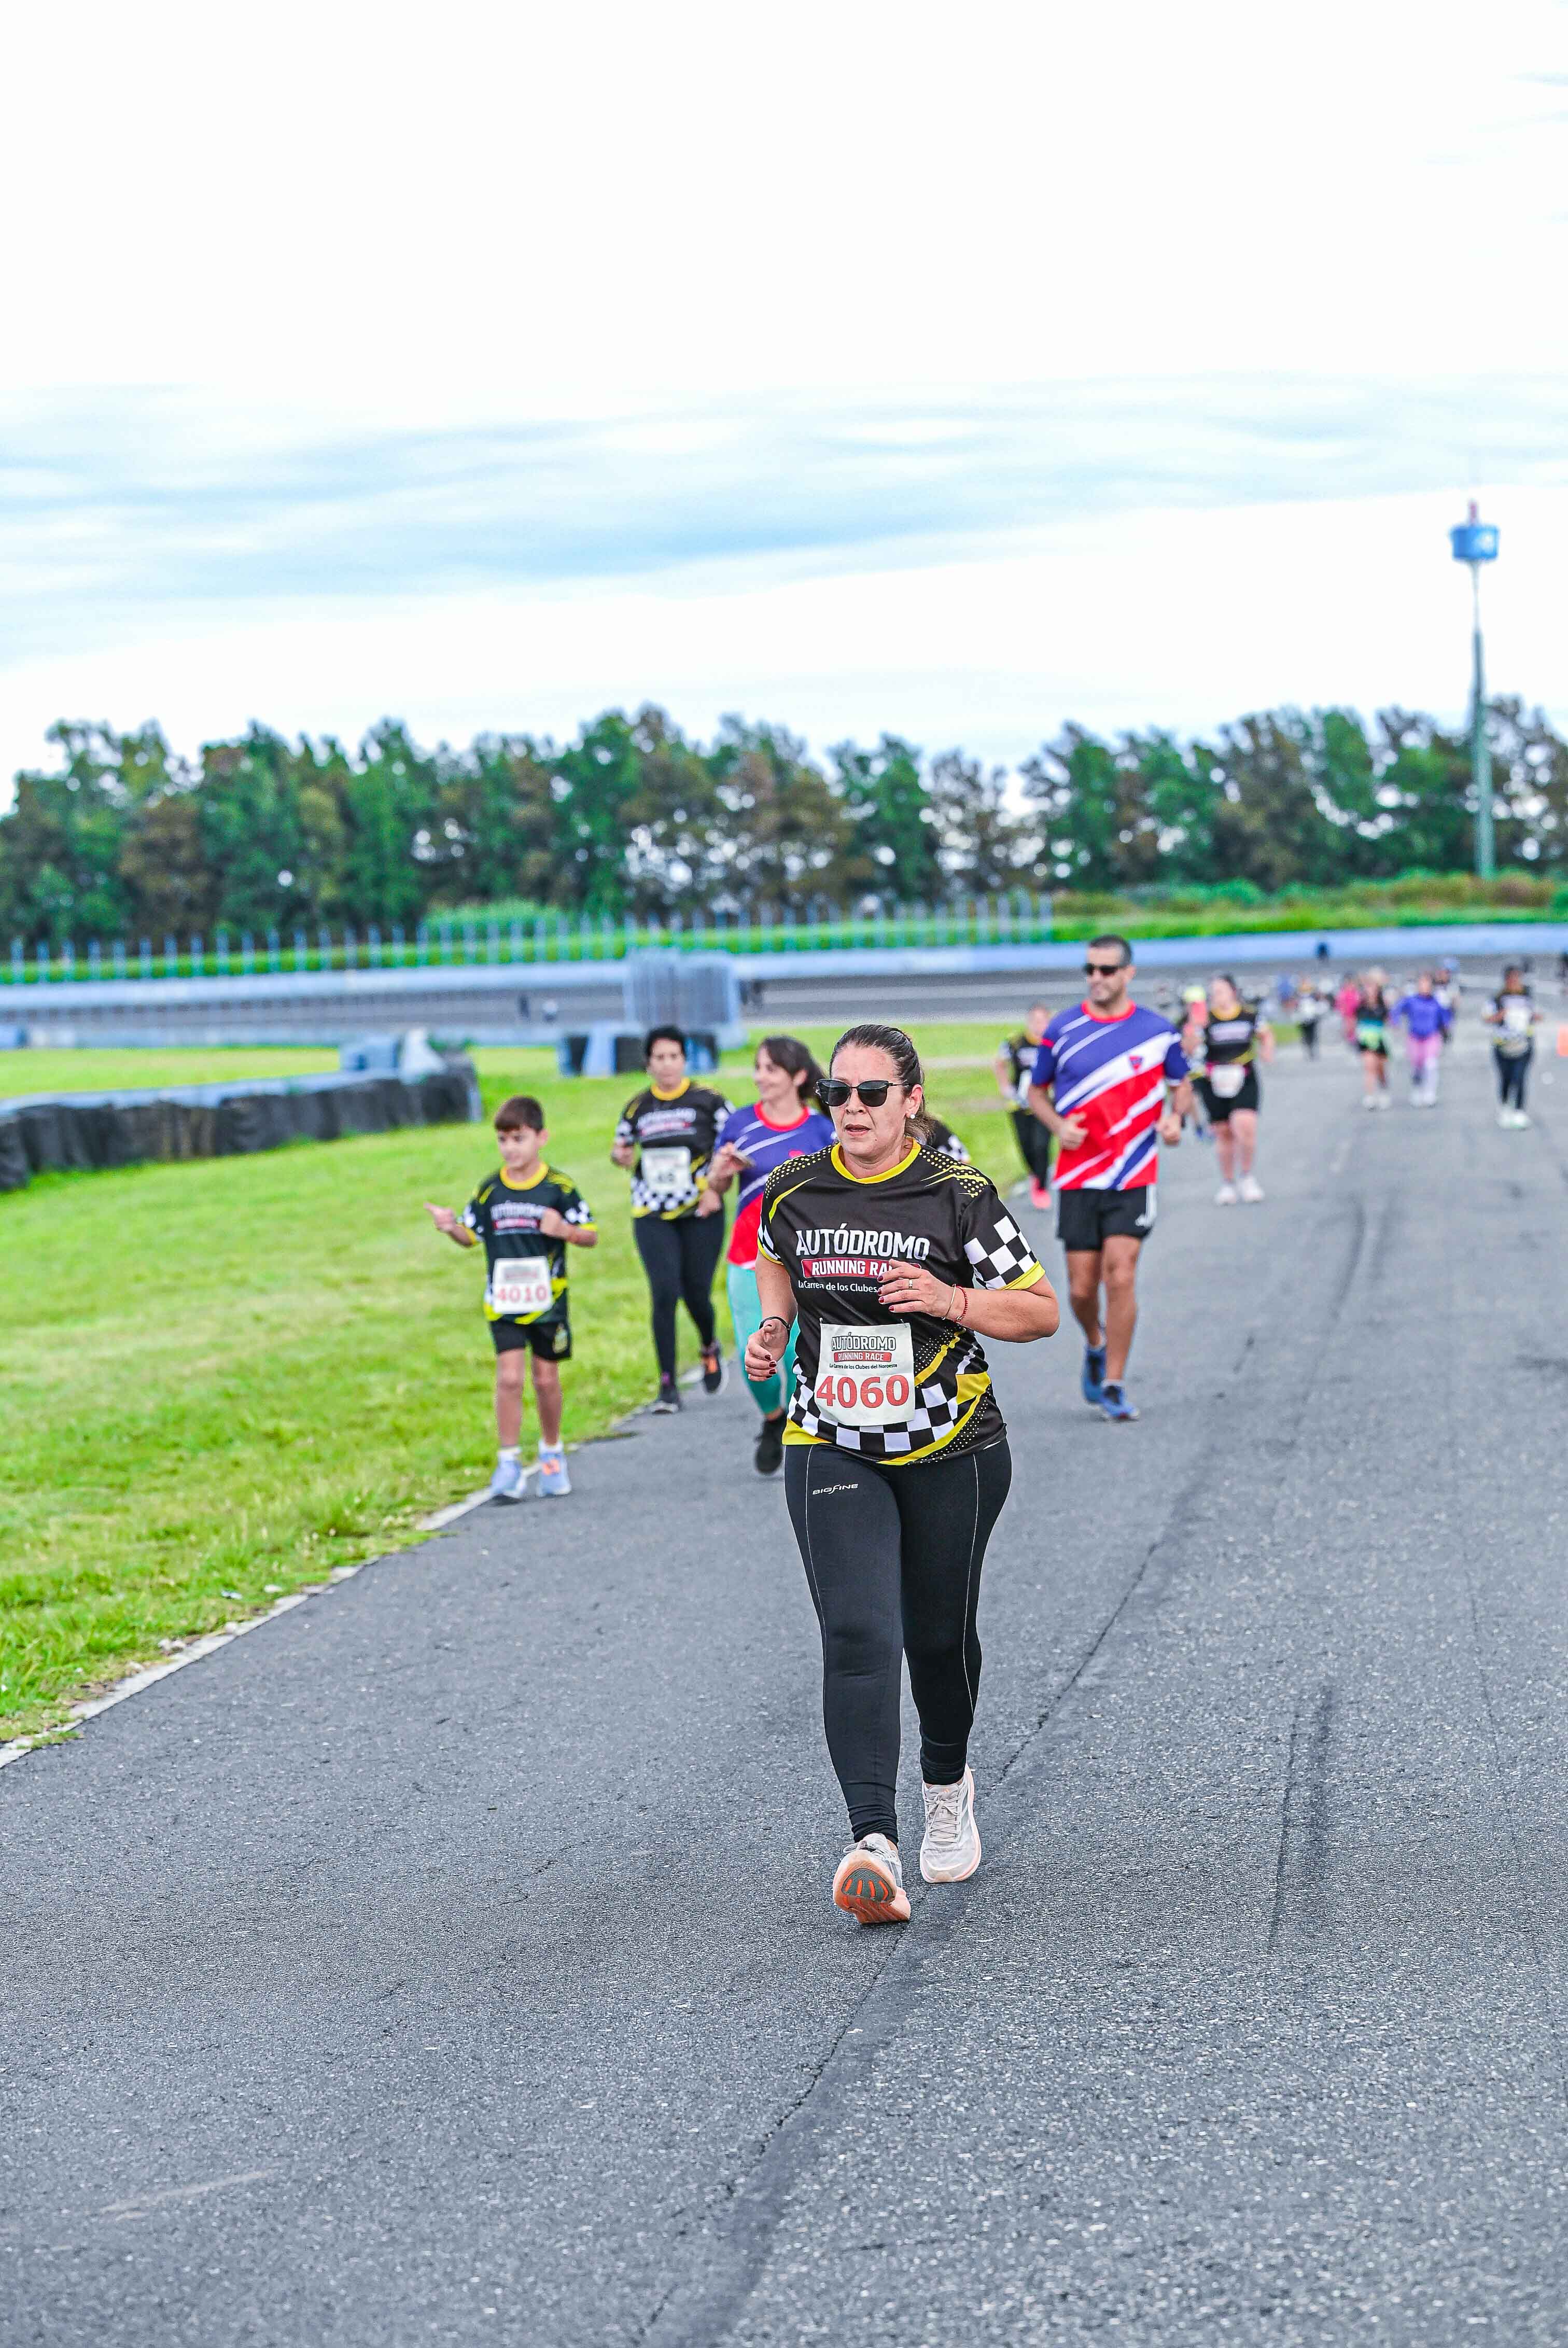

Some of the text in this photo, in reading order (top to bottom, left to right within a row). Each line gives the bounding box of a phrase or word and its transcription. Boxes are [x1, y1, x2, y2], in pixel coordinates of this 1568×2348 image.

[795, 1223, 930, 1261] AUTÓDROMO
[811, 1259, 892, 1277] RUNNING RA
[497, 1284, 548, 1303] 4010
[825, 1282, 836, 1291] de
[837, 1282, 849, 1291] los
[850, 1283, 878, 1293] Clubes
[831, 1332, 896, 1351] AUTÓDROMO
[838, 1352, 884, 1361] RUNNING RACE
[817, 1375, 909, 1408] 4060
